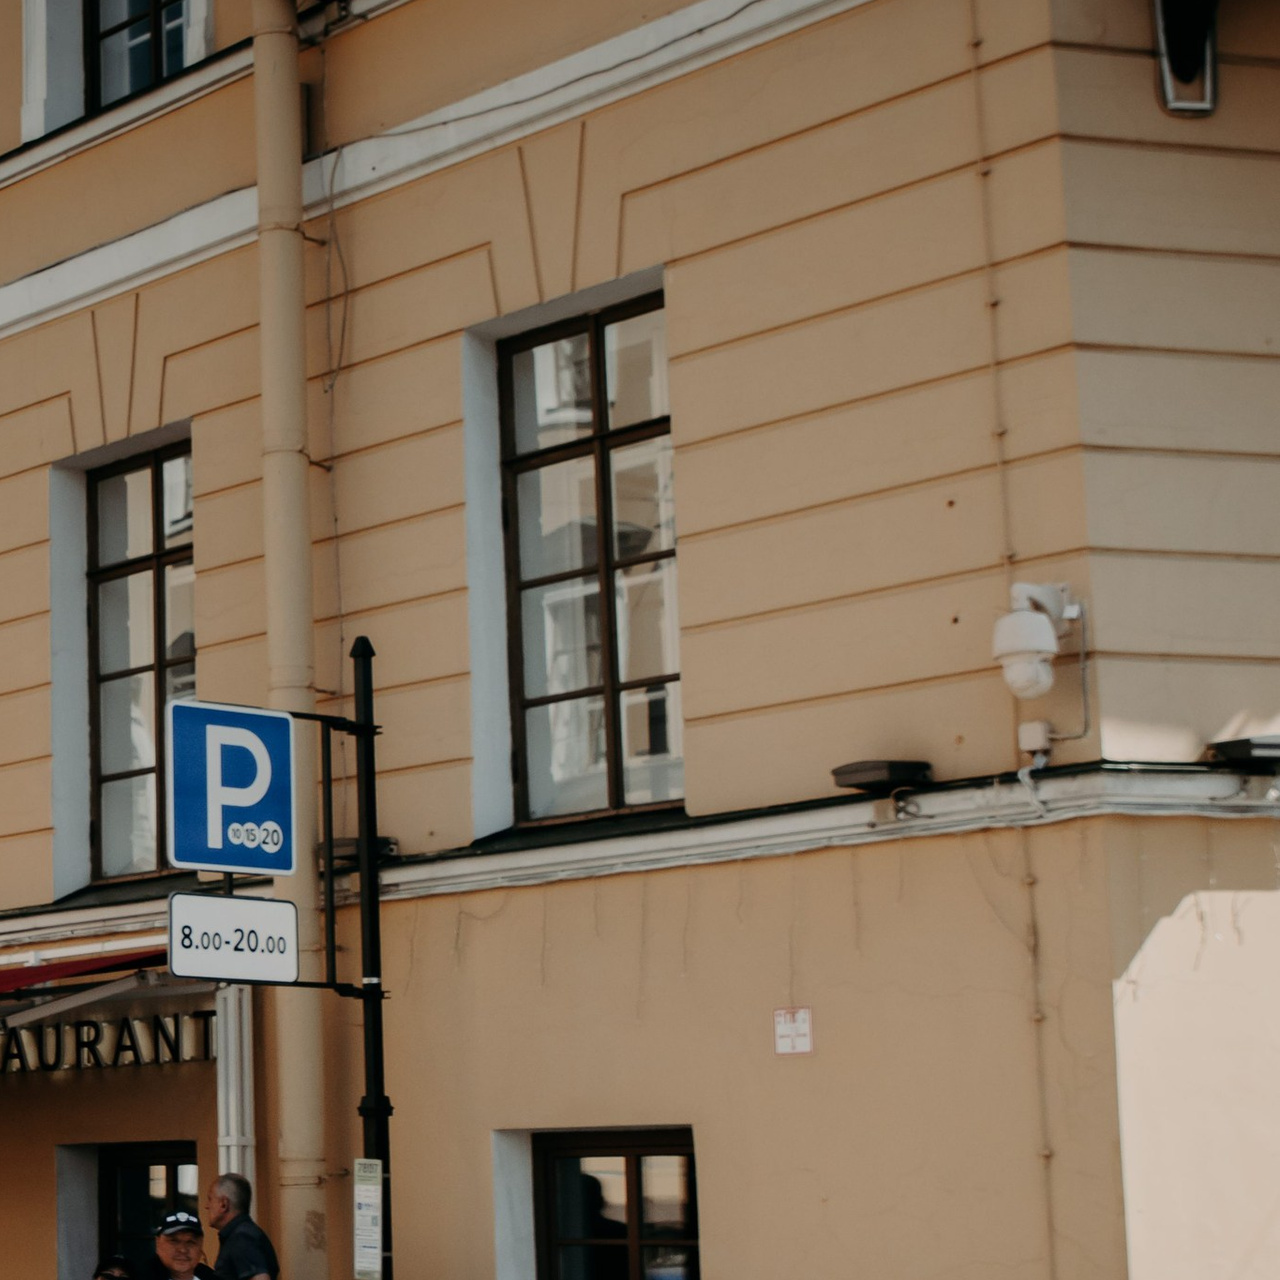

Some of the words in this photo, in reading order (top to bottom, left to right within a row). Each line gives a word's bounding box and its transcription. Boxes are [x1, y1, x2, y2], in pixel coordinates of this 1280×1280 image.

[206, 724, 272, 849] P
[245, 828, 257, 842] 15
[262, 827, 280, 846] 20
[181, 924, 287, 955] 8.00-20.00
